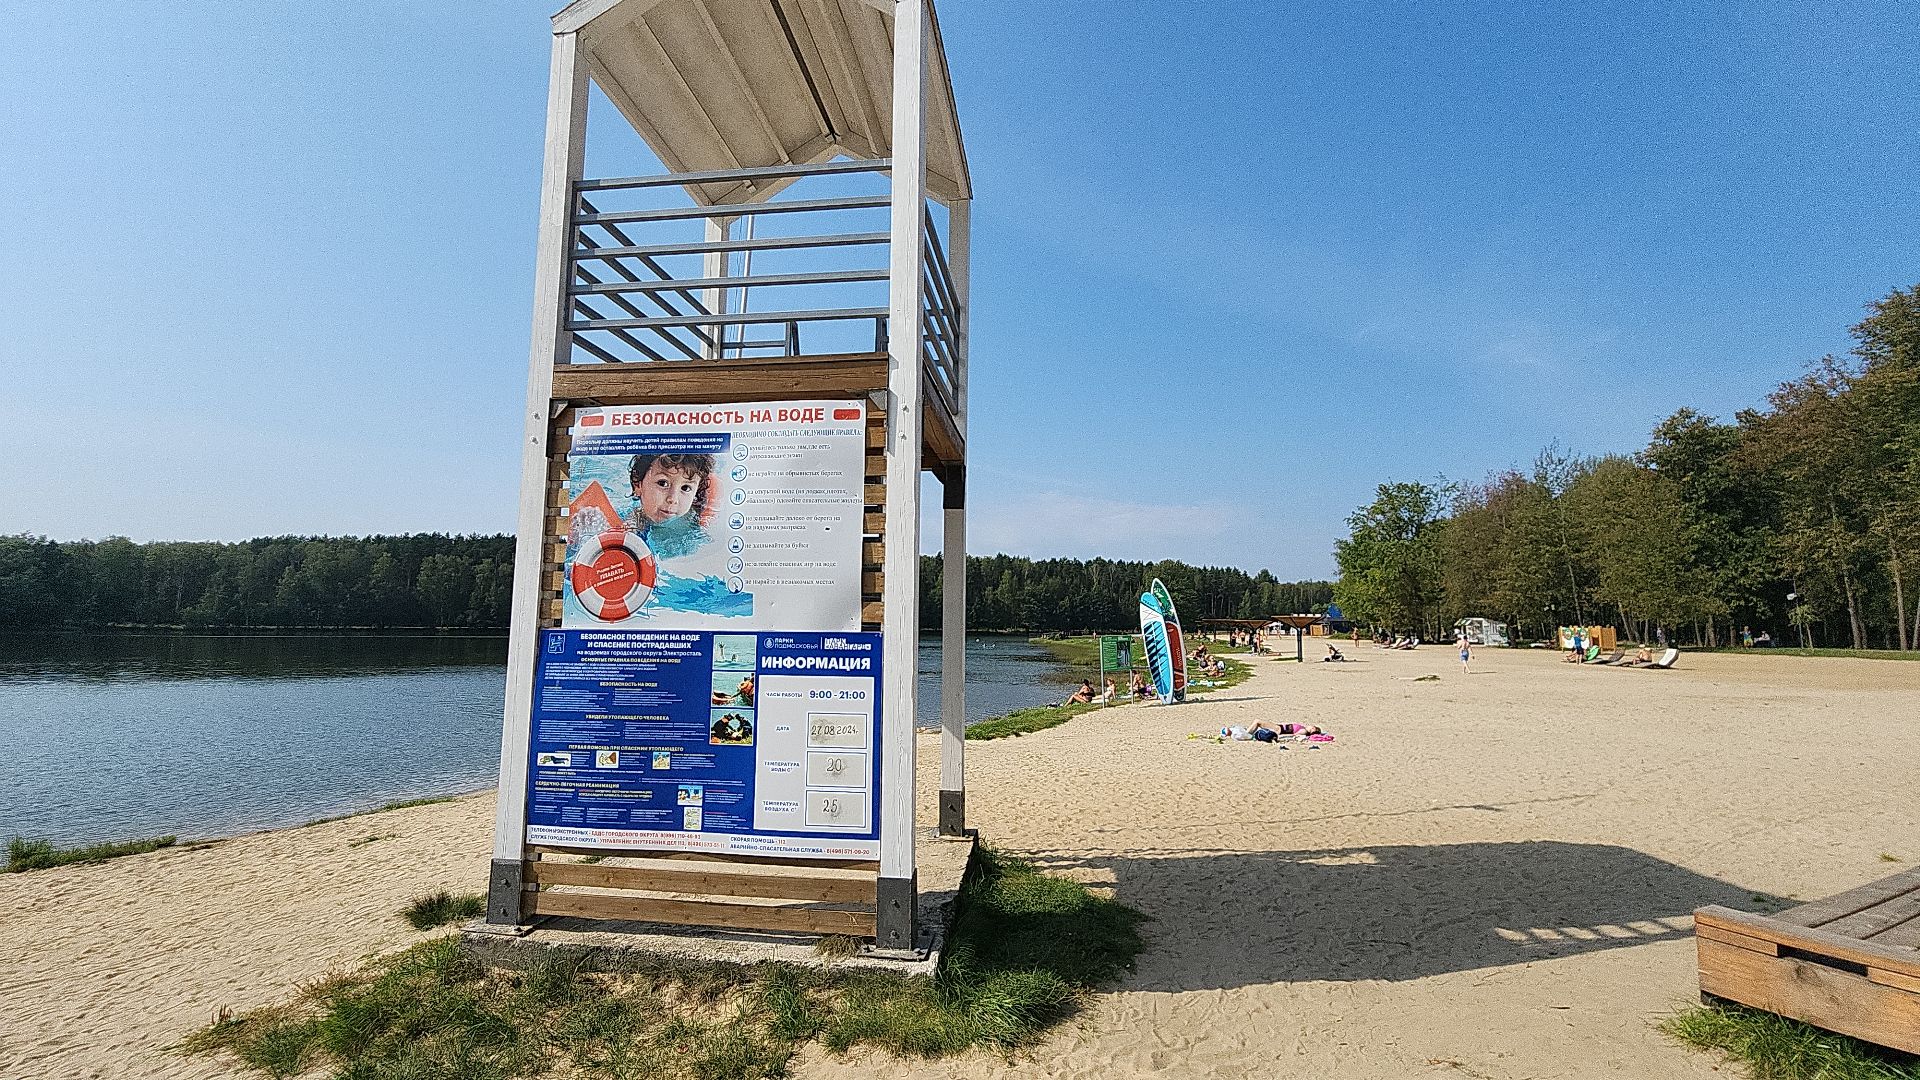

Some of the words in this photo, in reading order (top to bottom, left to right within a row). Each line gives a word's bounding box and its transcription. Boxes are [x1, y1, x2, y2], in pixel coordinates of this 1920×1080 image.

[611, 411, 744, 426] БЕЗОПАСНОСТЬ
[749, 410, 772, 423] НА
[778, 408, 825, 423] ВОДЕ
[599, 568, 624, 580] ПЛАВАТЬ
[580, 633, 625, 641] БЕЗОПАСНОЕ
[761, 656, 871, 671] ИНФОРМАЦИЯ
[809, 690, 832, 698] 9:00
[839, 691, 866, 699] 21:00
[826, 758, 842, 772] 20
[822, 799, 838, 813] 25
[730, 843, 800, 853] АВАРИЙНО-СПАСАТЕЛЬНАЯ
